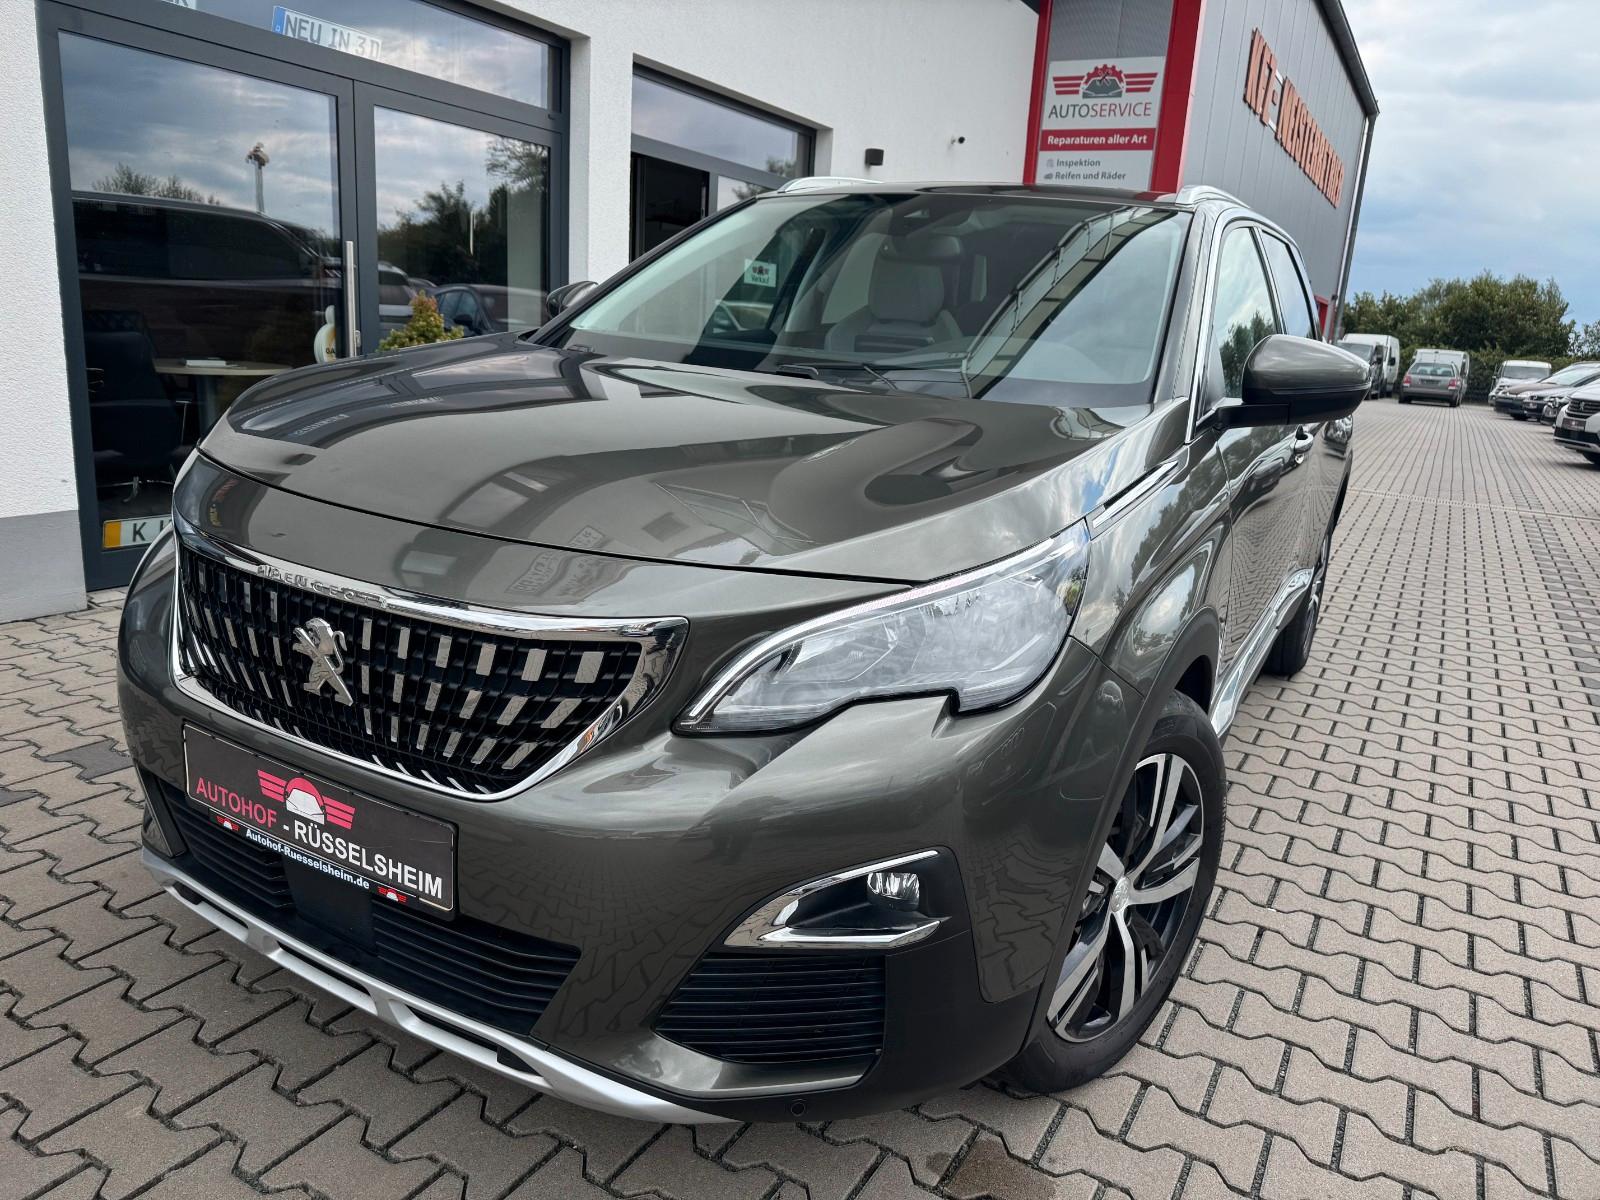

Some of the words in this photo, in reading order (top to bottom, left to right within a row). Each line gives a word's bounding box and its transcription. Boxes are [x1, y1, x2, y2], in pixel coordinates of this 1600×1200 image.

[285, 13, 322, 44] NEU
[328, 27, 350, 49] IN
[1048, 101, 1153, 119] AUTOSERVICE
[1047, 134, 1106, 147] Reparaturen
[1107, 134, 1130, 145] aller
[1131, 134, 1148, 144] Art
[1056, 158, 1101, 168] Inspektion
[1055, 171, 1081, 180] Reifen
[1082, 171, 1099, 180] und
[1101, 170, 1126, 180] Räder
[196, 777, 277, 829] AUTOHOF
[293, 818, 443, 900] RÜSSELSHEIM
[245, 828, 370, 890] Autohof-Ruesselsheim.de
